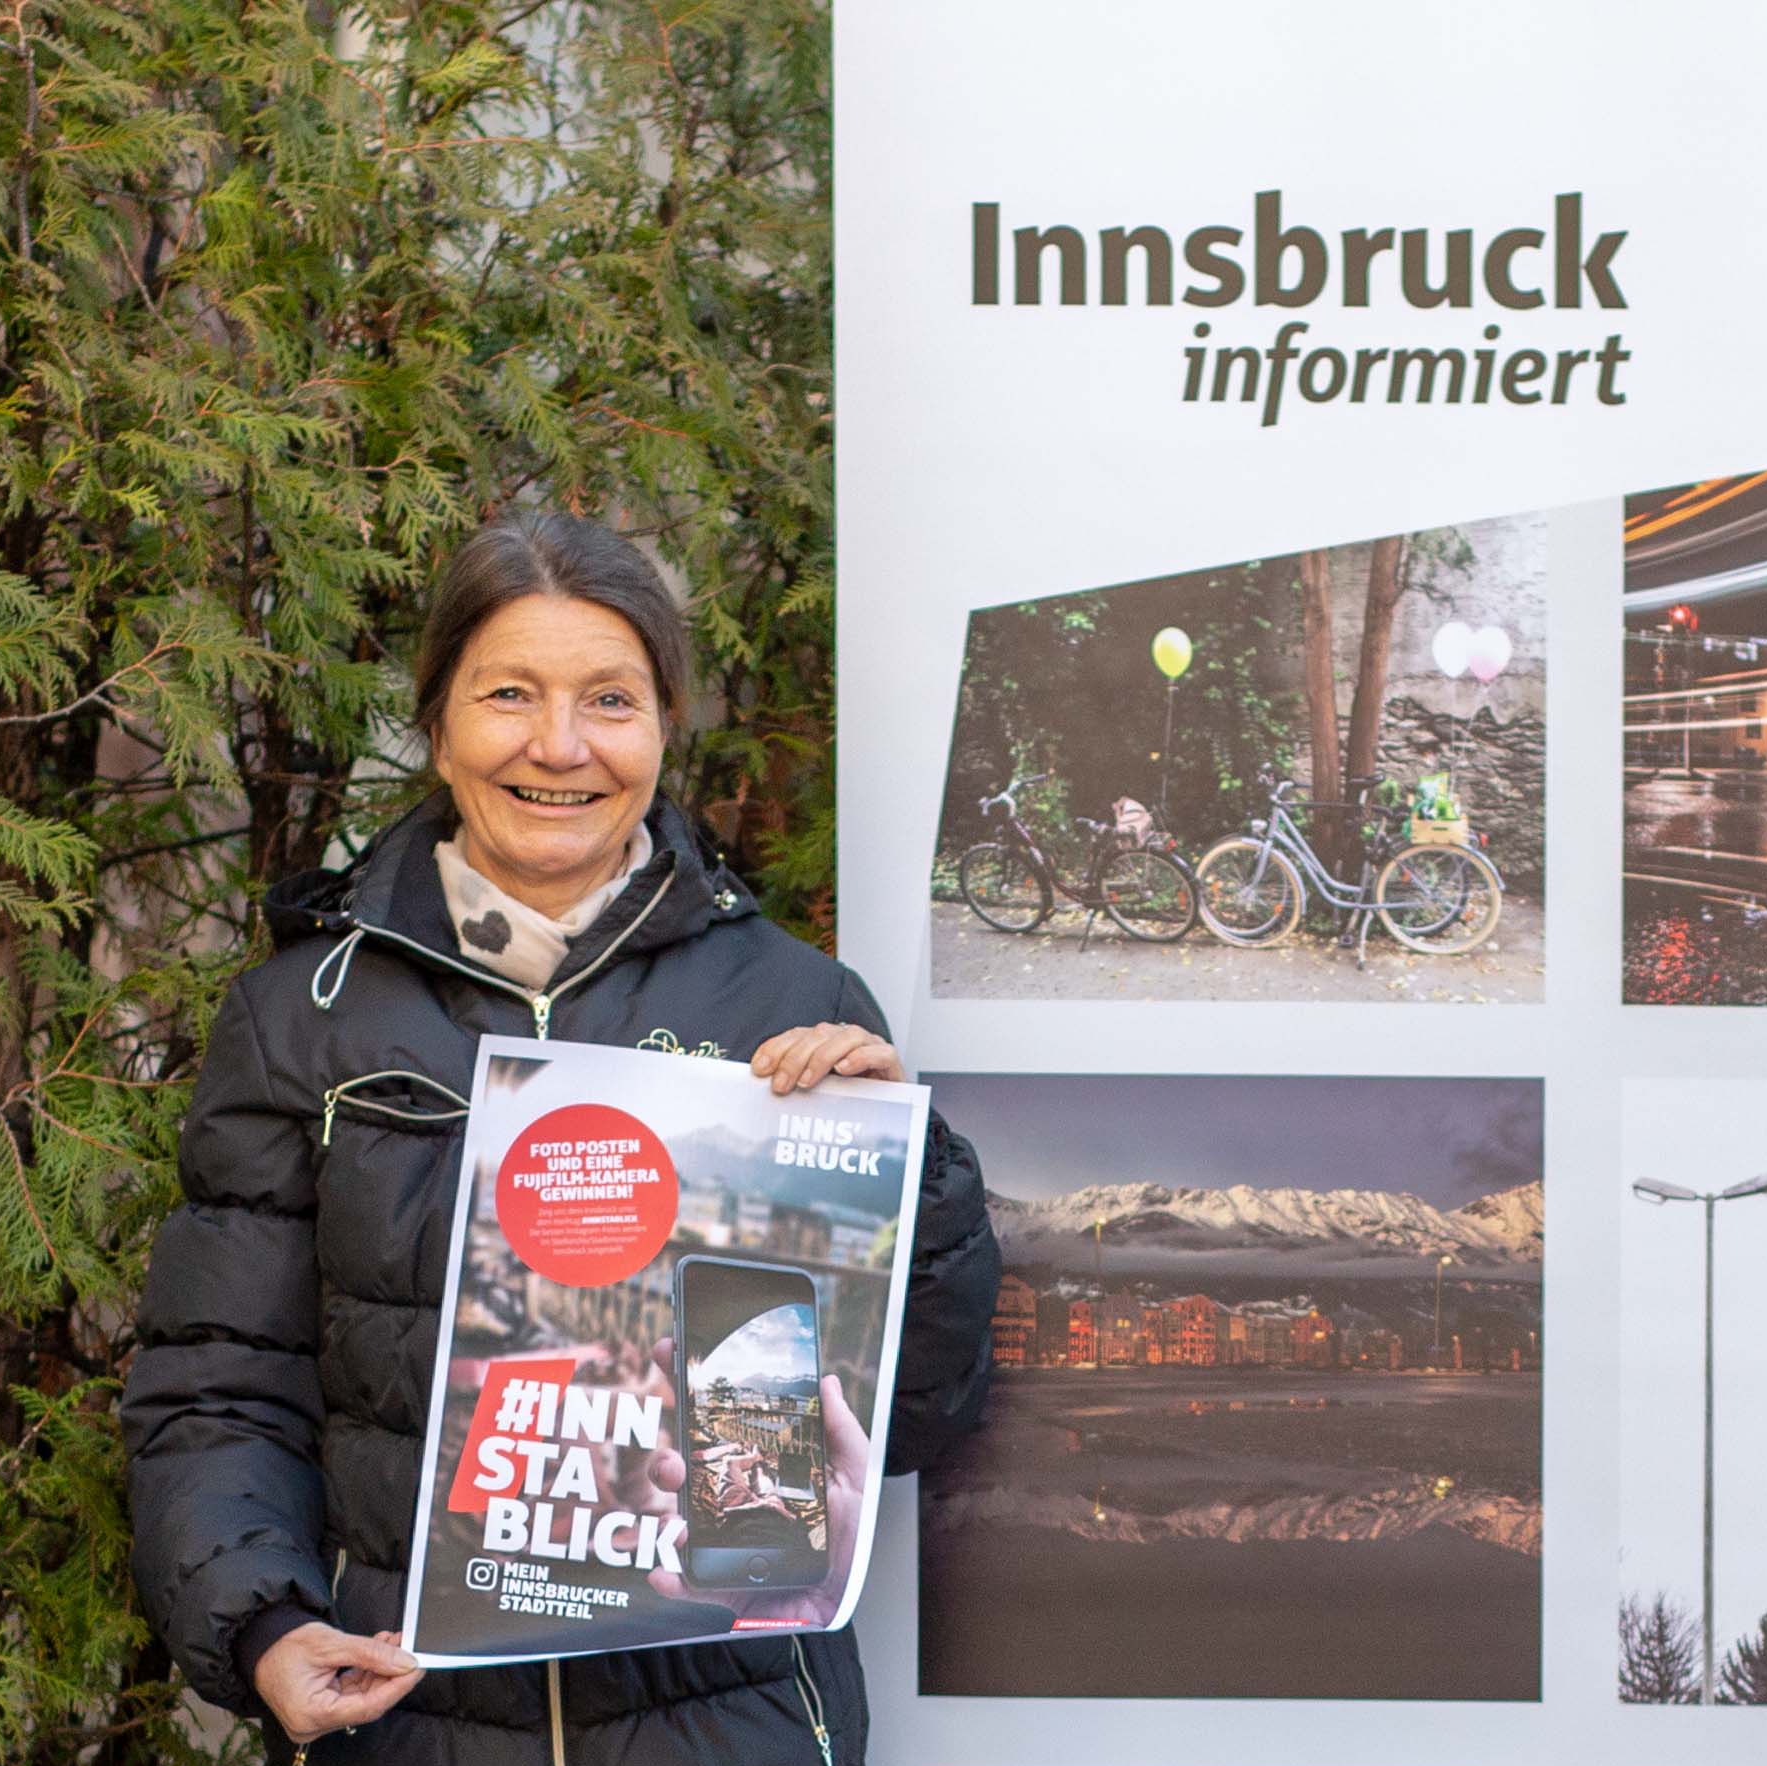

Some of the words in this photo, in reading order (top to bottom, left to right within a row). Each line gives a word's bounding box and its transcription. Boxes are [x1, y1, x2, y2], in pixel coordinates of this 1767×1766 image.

[971, 189, 1630, 311] Innsbruck
[1182, 321, 1633, 428] informiert
[530, 1142, 572, 1158] FOTO
[575, 1139, 640, 1155] POSTEN
[547, 1156, 582, 1171] UND
[586, 1155, 624, 1169] EINE
[775, 1140, 881, 1176] BRUCK
[513, 1168, 660, 1191] FUJIFILM-KAMERA
[540, 1185, 634, 1202] GEWINNEN!
[494, 1378, 663, 1450] #INN
[473, 1436, 599, 1502] STA
[483, 1496, 688, 1573] BLICK
[503, 1561, 549, 1581] MEIN
[499, 1594, 593, 1619] STADTTEIL
[501, 1578, 630, 1607] INNSBRUCKER
